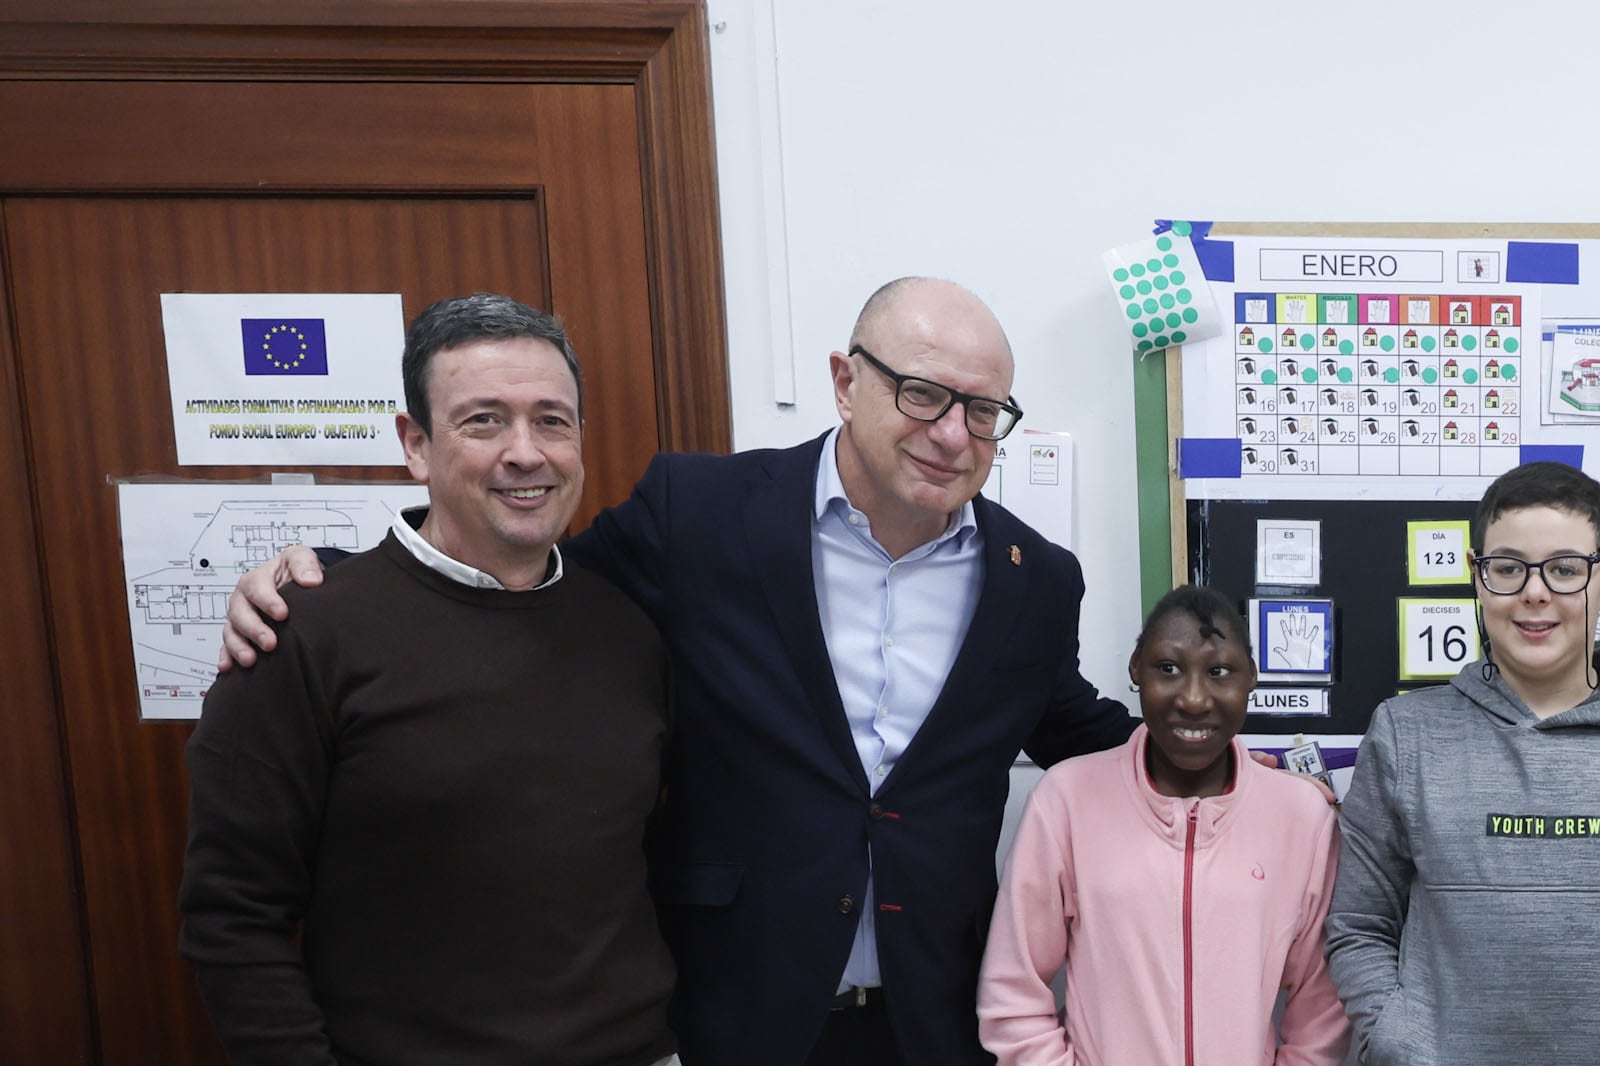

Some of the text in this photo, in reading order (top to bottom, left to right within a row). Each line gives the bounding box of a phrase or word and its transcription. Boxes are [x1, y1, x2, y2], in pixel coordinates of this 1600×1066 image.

[1303, 254, 1397, 277] ENERO
[185, 399, 398, 414] ACTIVIDADES FORMATIVAS COFINANCIADAS POR EL
[1261, 400, 1275, 412] 16
[1301, 400, 1316, 413] 17
[1341, 401, 1355, 413] 18
[1382, 401, 1397, 414] 19
[1420, 402, 1437, 414] 20
[1460, 402, 1475, 414] 21
[1501, 402, 1518, 415] 22
[209, 424, 240, 439] FONDO
[242, 424, 274, 439] SOCIAL
[275, 424, 317, 439] EUROPEO
[323, 424, 367, 439] OBJETIVO
[369, 424, 376, 439] 3
[1259, 431, 1276, 443] 23
[1299, 431, 1316, 443] 24
[1339, 431, 1356, 443] 25
[1380, 432, 1397, 444] 26
[1422, 432, 1437, 444] 27
[1460, 432, 1476, 444] 28
[1501, 432, 1518, 445] 29
[1259, 459, 1276, 472] 30
[1300, 459, 1316, 472] 31
[1283, 531, 1295, 539] ES
[1432, 532, 1446, 540] DÍA
[1282, 605, 1309, 613] LUNES
[1422, 606, 1461, 614] DIECISEIS
[1418, 625, 1467, 663] 16
[1254, 694, 1309, 708] LUNES
[1491, 816, 1600, 835] YOUTH CREW
